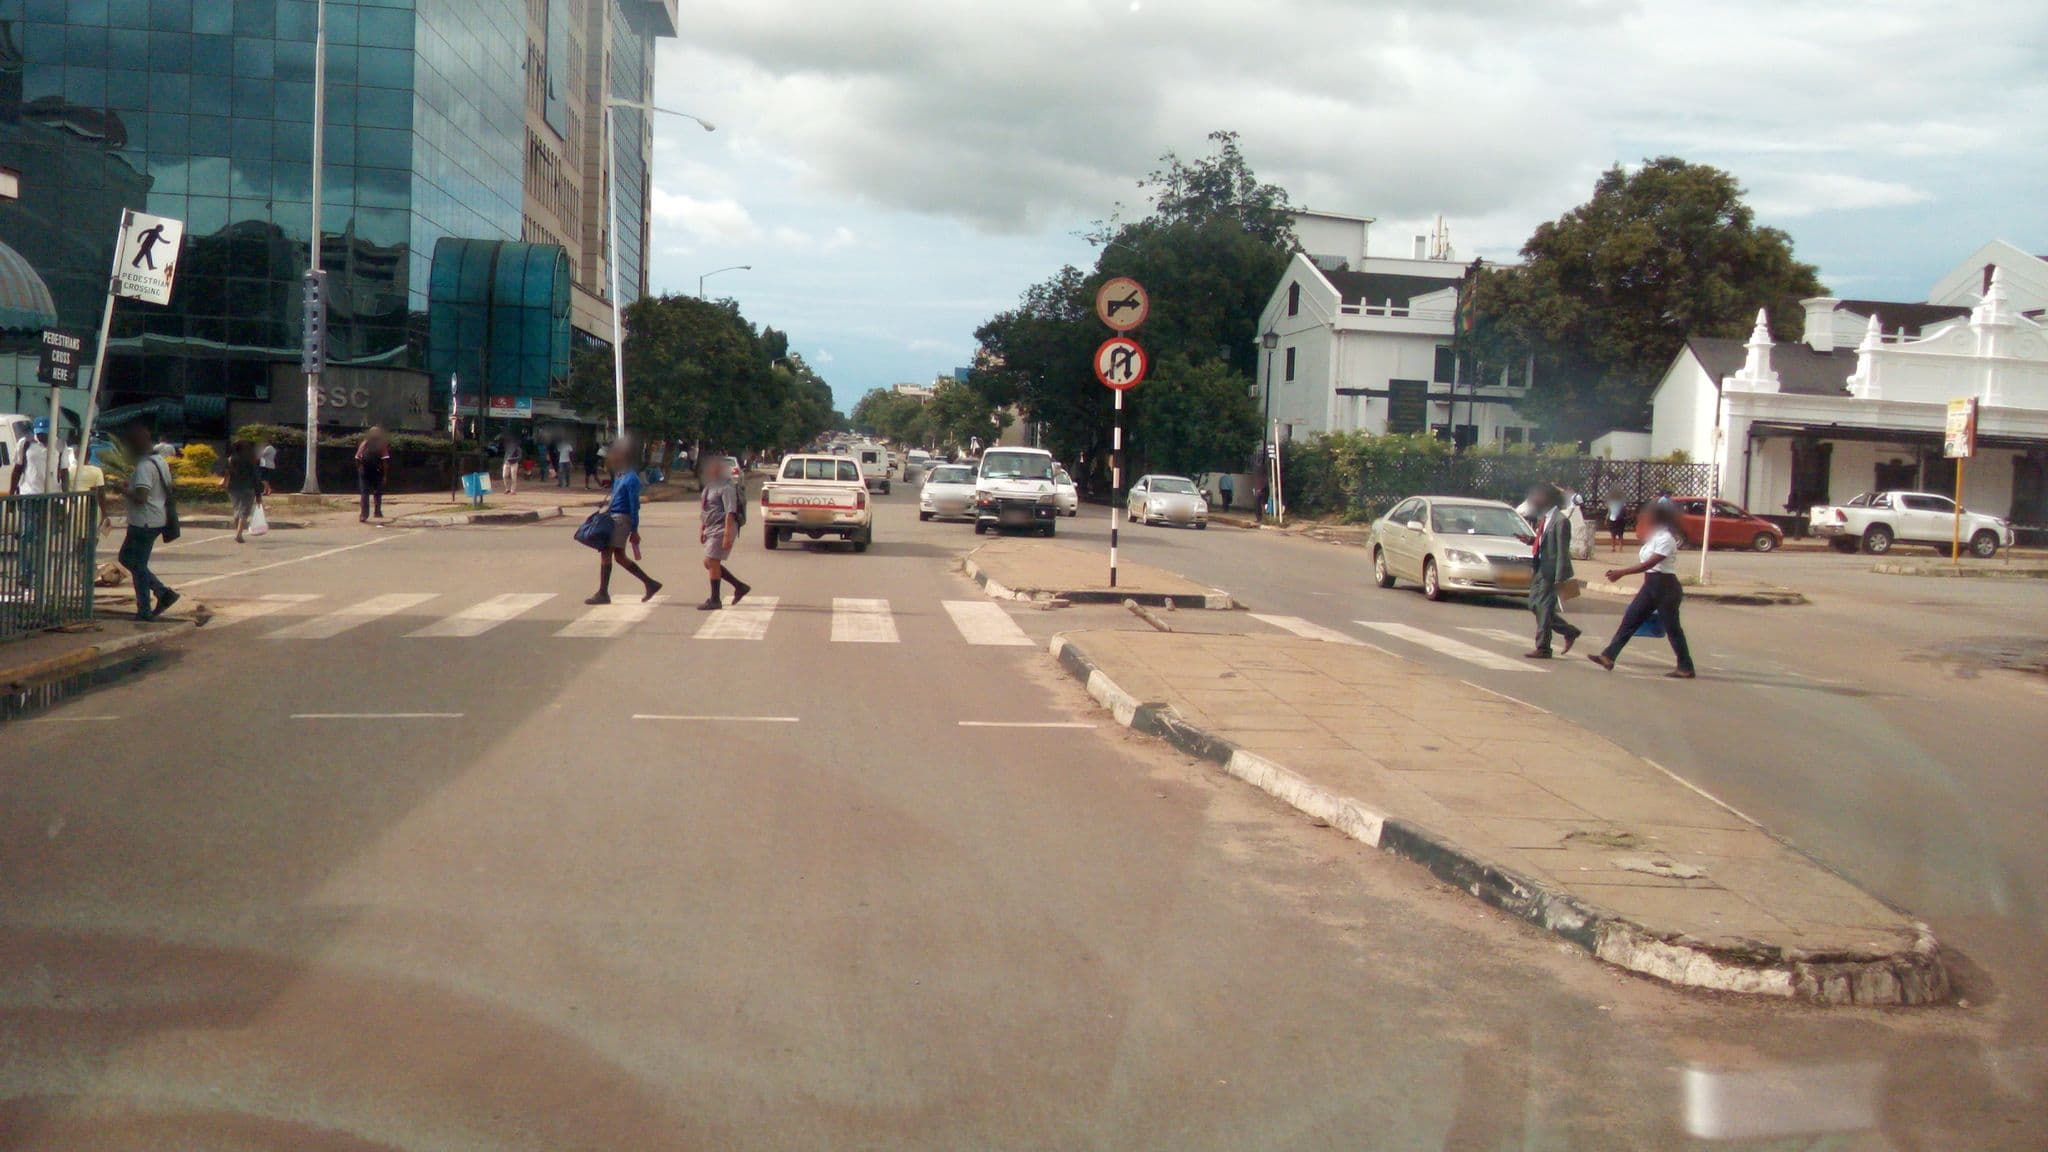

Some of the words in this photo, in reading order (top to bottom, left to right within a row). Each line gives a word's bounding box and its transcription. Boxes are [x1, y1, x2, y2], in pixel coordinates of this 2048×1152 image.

[124, 282, 160, 296] CROSSING
[43, 331, 80, 350] PEDESTRIANS
[52, 349, 70, 365] CROSS
[52, 367, 68, 381] HERE
[791, 497, 835, 505] TOYOTA
